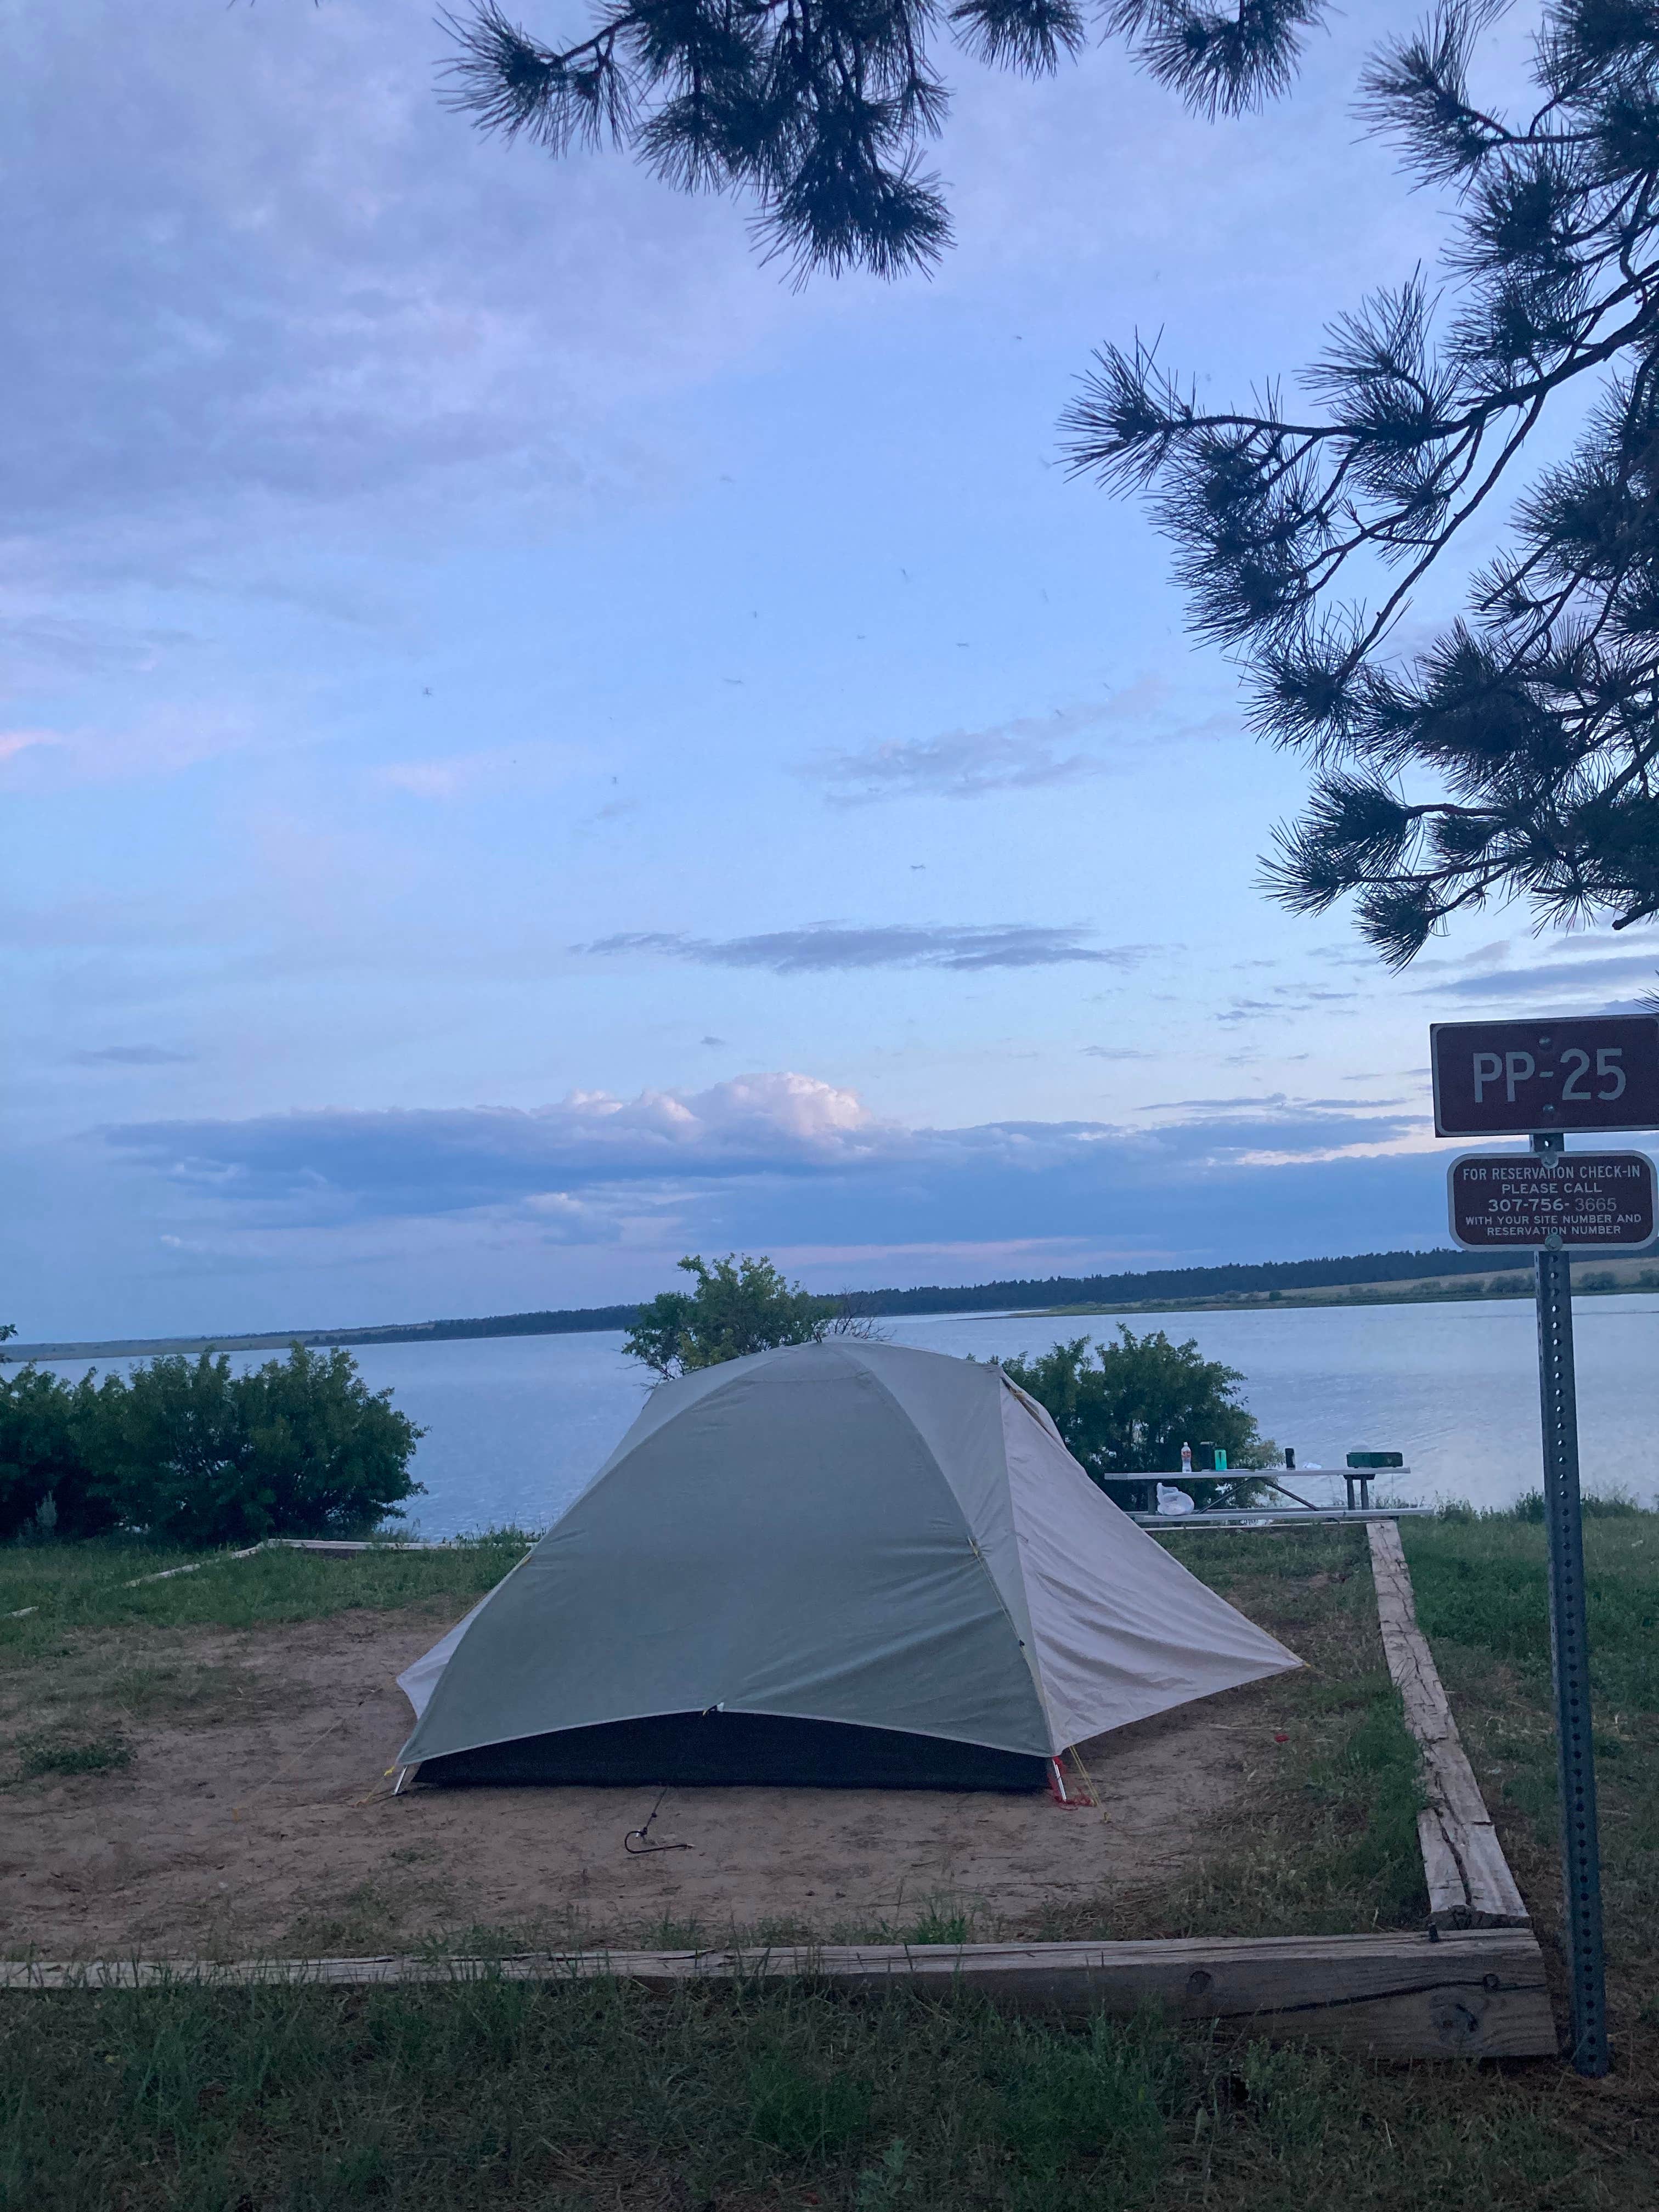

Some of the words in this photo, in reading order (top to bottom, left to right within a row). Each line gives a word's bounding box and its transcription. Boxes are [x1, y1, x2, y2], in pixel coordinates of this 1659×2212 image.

[1472, 1048, 1627, 1103] PP-25
[1463, 1167, 1487, 1181] FOR
[1492, 1166, 1575, 1180] RESERVATION
[1579, 1165, 1640, 1179] CHECK-IN
[1502, 1183, 1559, 1194] PLEASE
[1563, 1182, 1602, 1193] CALL
[1465, 1216, 1493, 1226] WITH
[1497, 1215, 1530, 1225] YOUR
[1533, 1215, 1559, 1224] SITE
[1562, 1214, 1612, 1224] NUMBER
[1616, 1213, 1642, 1223] AND
[1487, 1226, 1567, 1236] RESERVATION
[1571, 1224, 1621, 1235] NUMBER
